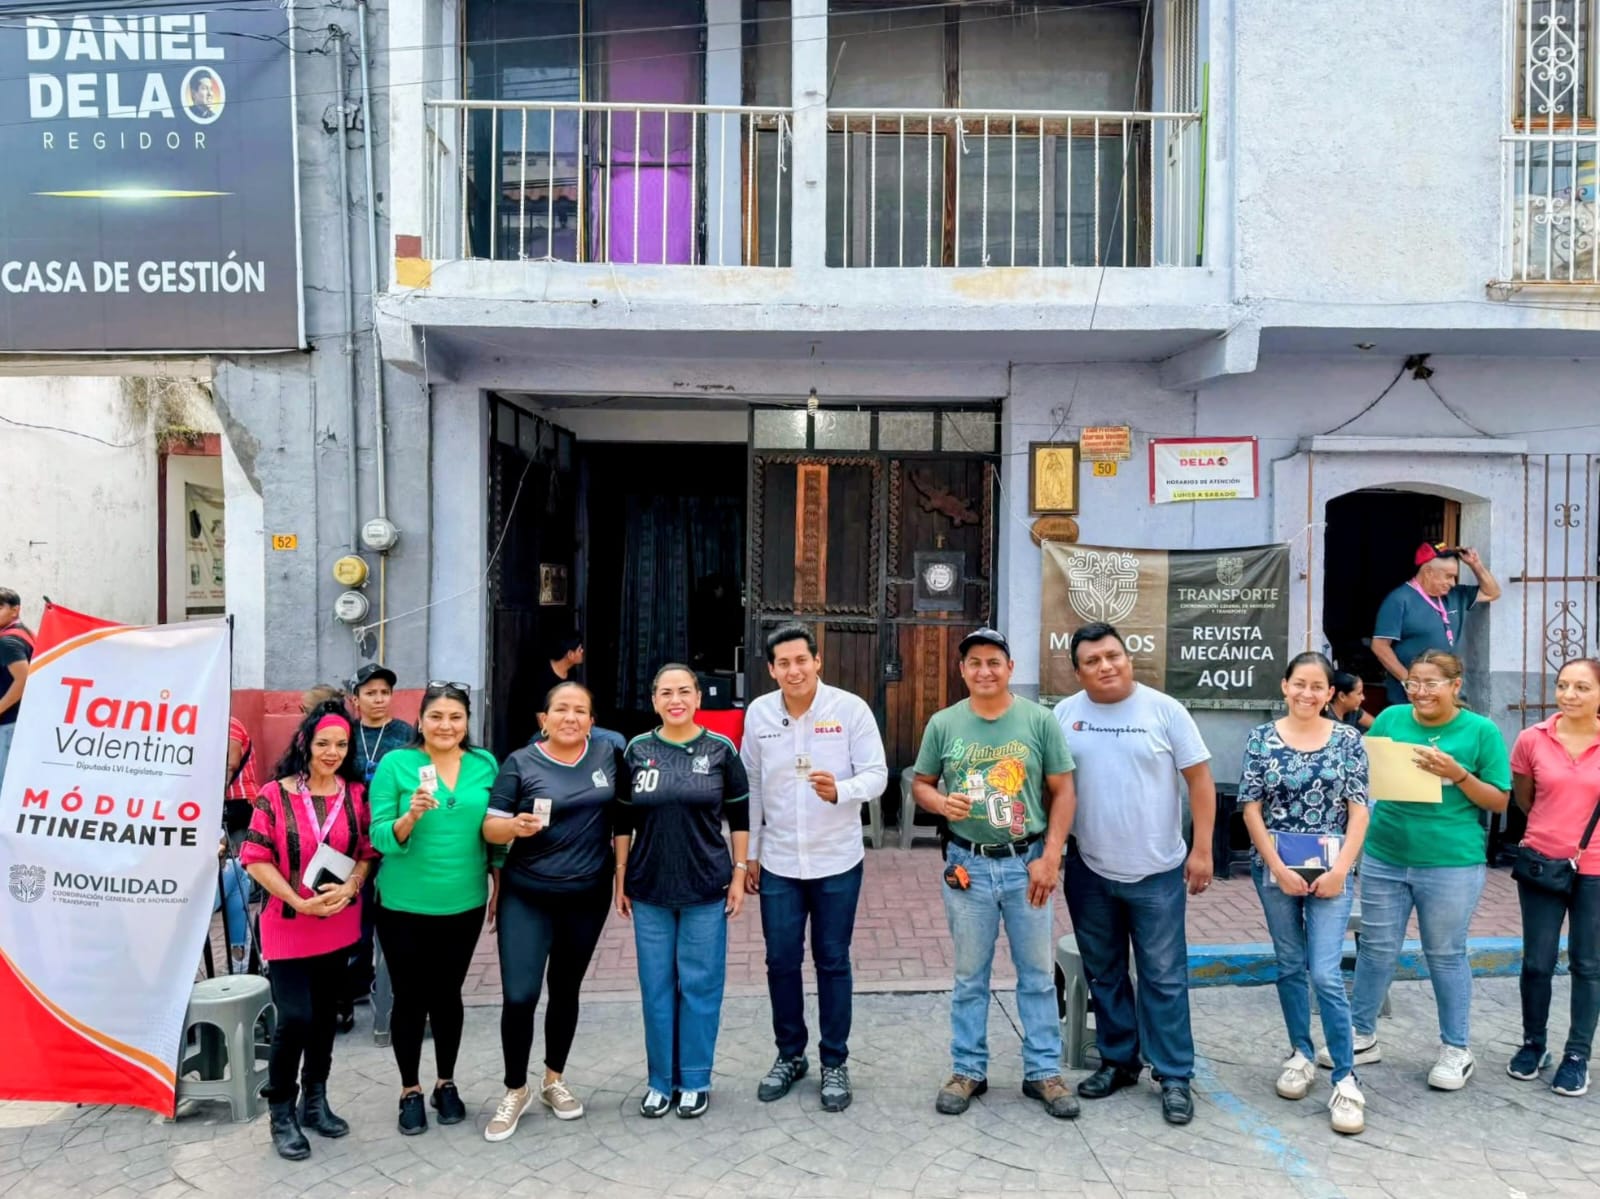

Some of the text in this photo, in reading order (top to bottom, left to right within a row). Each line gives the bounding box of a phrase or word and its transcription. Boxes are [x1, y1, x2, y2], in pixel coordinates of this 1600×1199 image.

[26, 14, 225, 61] DANIEL
[43, 131, 206, 150] REGIDOR
[1, 250, 265, 293] CASA DE GESTIÓN
[1098, 462, 1112, 475] 50
[277, 536, 293, 549] 52
[1177, 587, 1279, 601] TRANSPORTE
[1192, 625, 1263, 641] REVISTA
[1180, 642, 1275, 661] MECÁNICA
[1196, 665, 1256, 690] AQUÍ
[60, 677, 199, 735] Tania
[1072, 720, 1148, 738] Champion
[55, 727, 195, 765] Valentina
[76, 761, 164, 777] Diputada LVI Legislatura
[634, 769, 659, 793] 30
[22, 786, 201, 822] MÓDULO
[16, 814, 197, 847] ITINERANTE
[53, 871, 178, 895] MOVILIDAD
